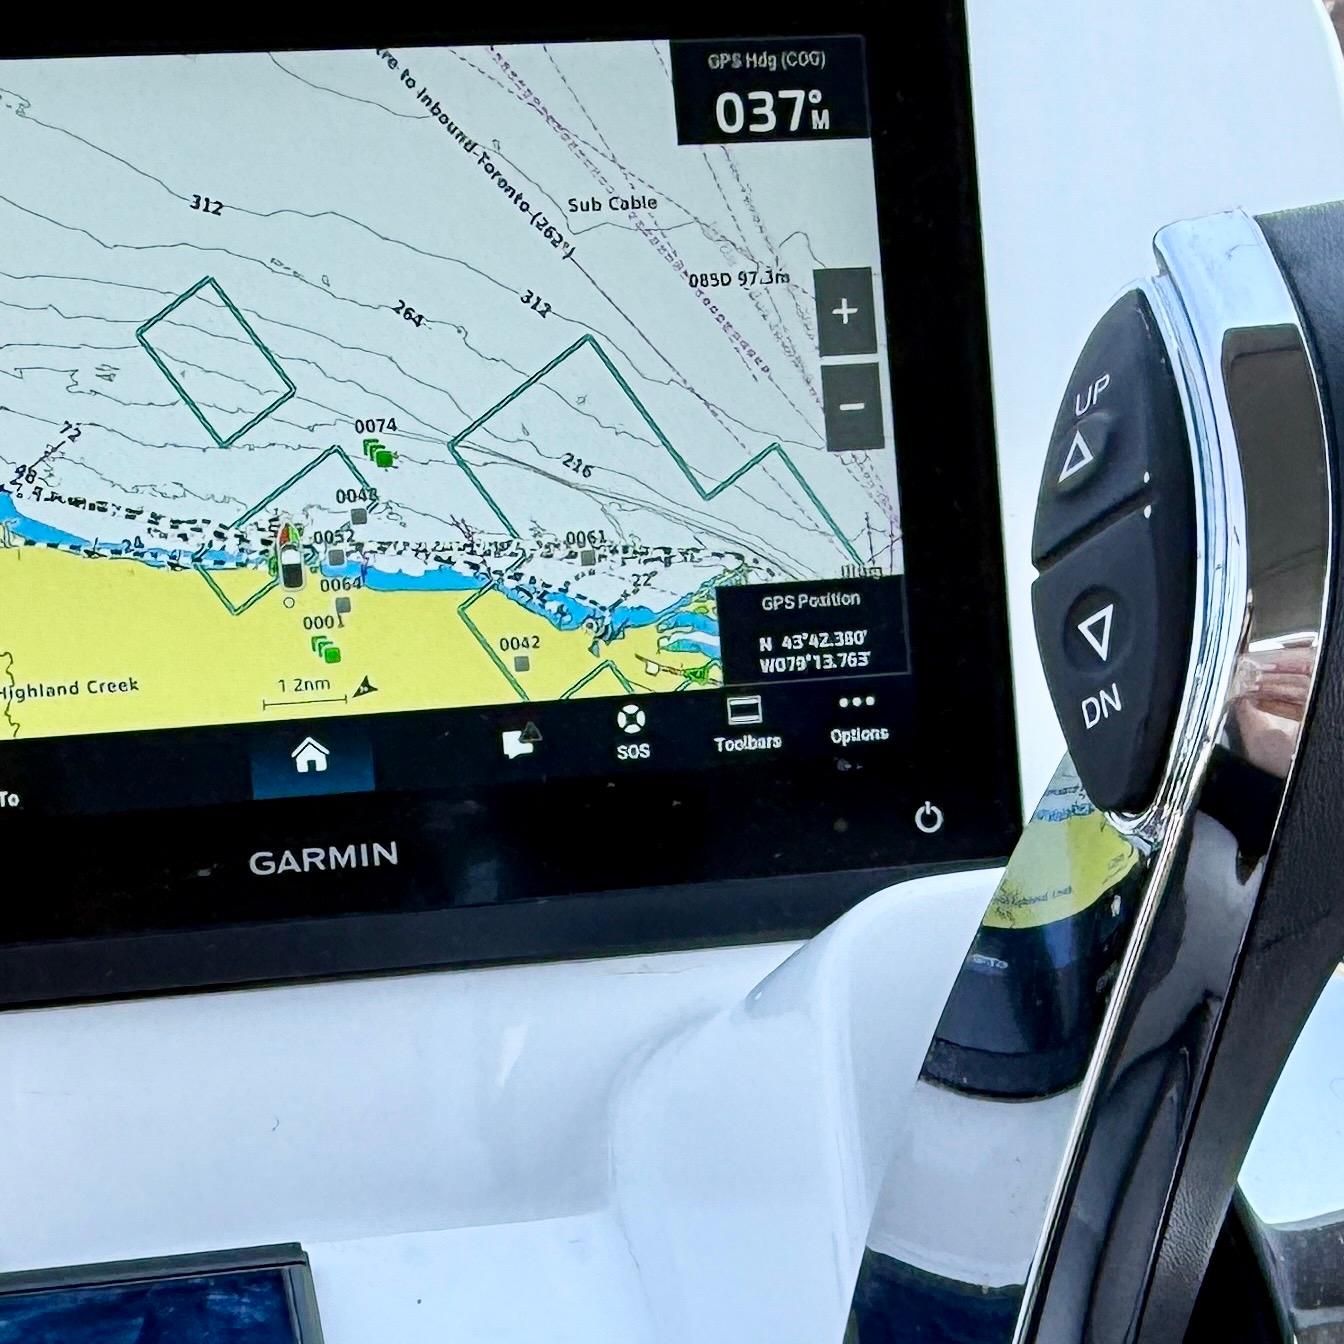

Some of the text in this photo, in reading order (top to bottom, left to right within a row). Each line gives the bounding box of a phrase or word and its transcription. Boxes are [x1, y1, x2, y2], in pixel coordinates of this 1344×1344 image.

[708, 53, 742, 69] GPS
[746, 51, 777, 71] Hdg
[189, 194, 223, 215] 312
[568, 195, 658, 212] Sub Cable
[1074, 374, 1110, 417] UP
[355, 418, 397, 433] 0074
[762, 592, 861, 611] GPS Position
[500, 636, 540, 651] 0042
[87, 678, 140, 693] Creek
[1081, 682, 1122, 730] DN
[714, 734, 783, 752] Toolbars
[830, 727, 889, 747] Options
[617, 744, 650, 760] SOS
[249, 841, 398, 876] GARMIN
